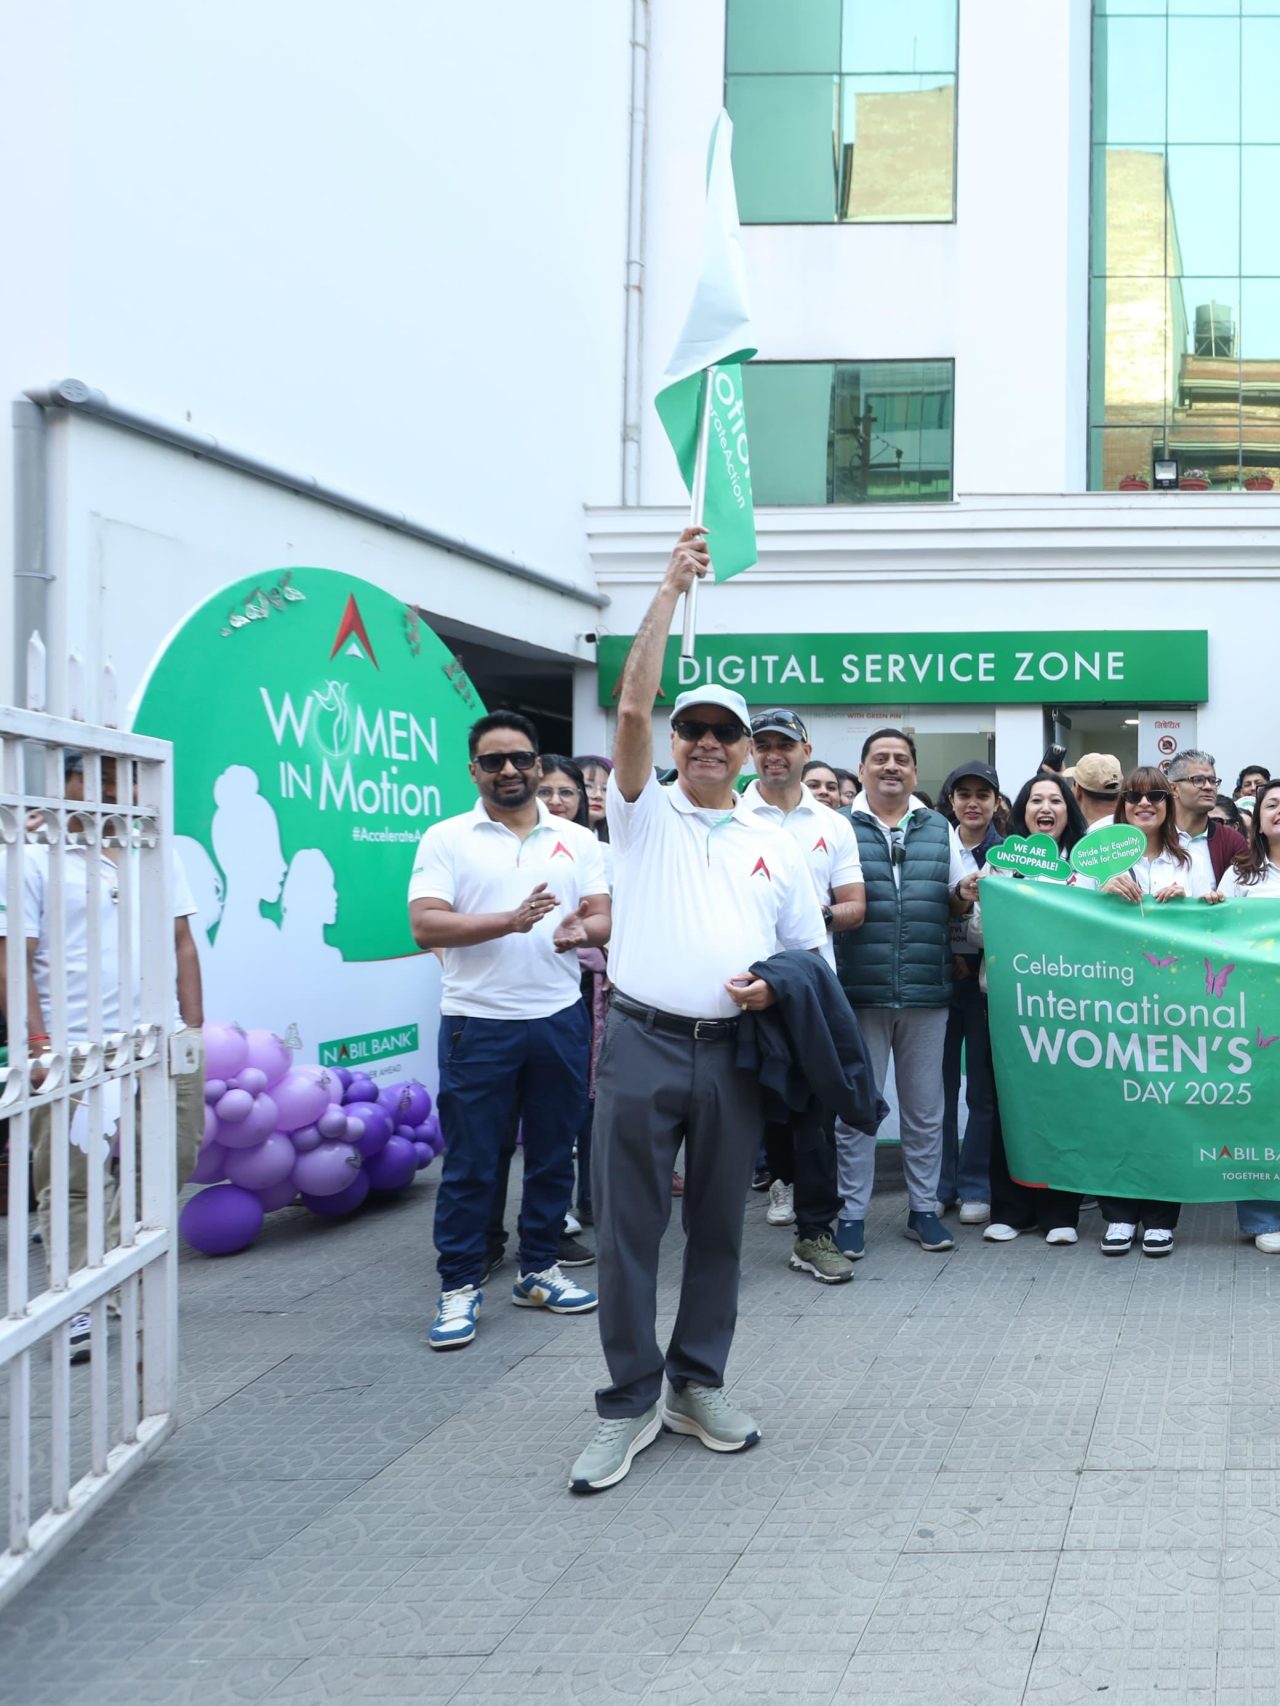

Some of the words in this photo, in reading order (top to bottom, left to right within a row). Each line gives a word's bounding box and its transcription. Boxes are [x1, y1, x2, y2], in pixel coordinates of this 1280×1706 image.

[715, 372, 752, 496] otio
[710, 402, 745, 509] rateAction
[678, 654, 824, 685] DIGITAL
[841, 653, 995, 684] SERVICE
[1013, 651, 1124, 681] ZONE
[259, 680, 438, 765] WOMEN
[280, 761, 312, 800] IN
[319, 757, 441, 817] Motion
[996, 852, 1060, 872] UNSTOPPABLE!
[1013, 842, 1029, 853] WE
[1029, 845, 1047, 858] ARE
[1077, 848, 1099, 859] Stride
[1100, 844, 1110, 854] for
[1079, 857, 1100, 868] Walk
[1100, 853, 1110, 863] for
[1111, 846, 1141, 860] Change!
[1012, 953, 1134, 987] Celebrating
[1016, 982, 1246, 1029] International
[323, 1043, 370, 1066] NABIL
[371, 1032, 412, 1055] BANK
[1019, 1025, 1253, 1075] WOMEN'S
[1123, 1079, 1175, 1104] DAY
[1185, 1081, 1252, 1105] 2025
[1200, 1145, 1260, 1162] NABIL
[1221, 1172, 1271, 1181] TOGETHER
